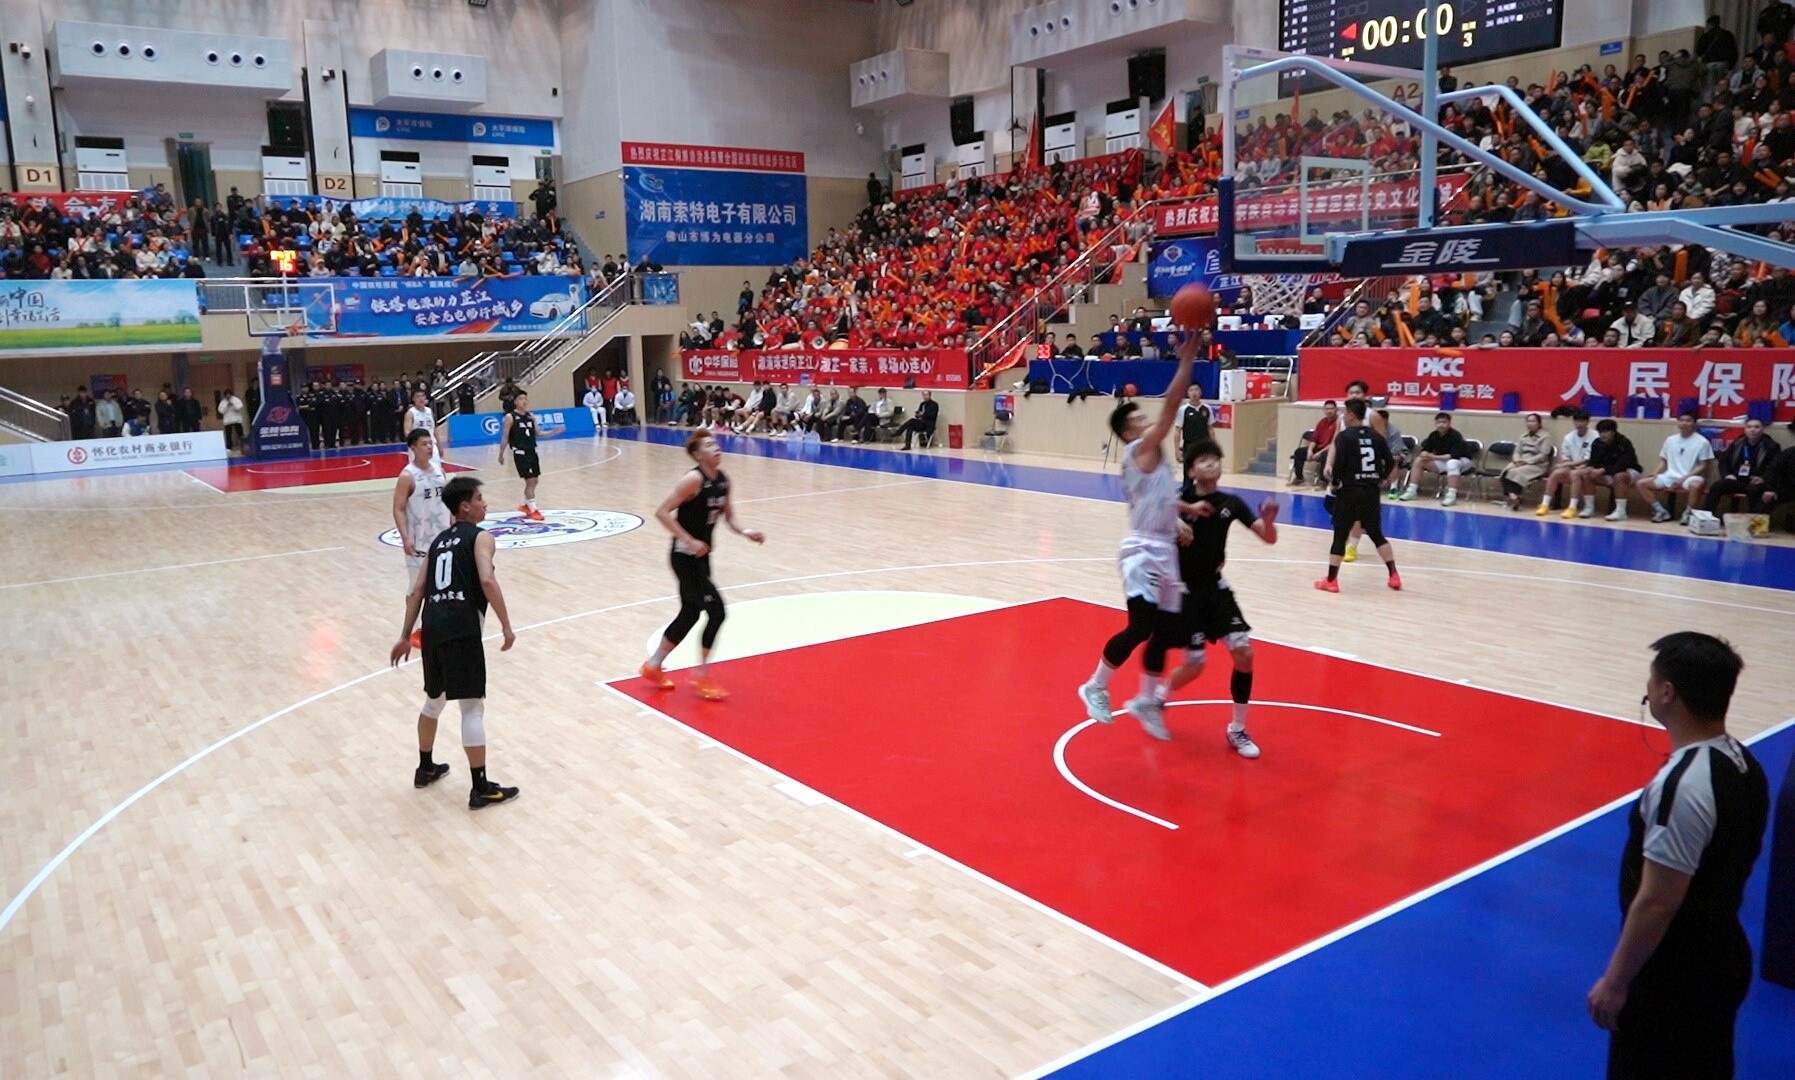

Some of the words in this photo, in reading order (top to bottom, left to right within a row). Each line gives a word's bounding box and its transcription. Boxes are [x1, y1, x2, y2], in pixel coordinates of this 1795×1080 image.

[1362, 3, 1454, 50] 00:00
[1462, 32, 1473, 47] 3
[1394, 83, 1419, 99] A2
[27, 168, 51, 182] D1
[324, 177, 346, 190] D2
[639, 199, 797, 226] 湖南索特电子有限公司
[1399, 239, 1482, 266] 金陵
[370, 289, 492, 314] 铁塔能源助力芷江
[414, 299, 524, 327] 安全充电畅行城乡
[1416, 356, 1465, 377] PICC
[91, 440, 193, 457] 怀化农村商业银行
[1360, 446, 1376, 472] 2
[435, 550, 453, 590] 0
